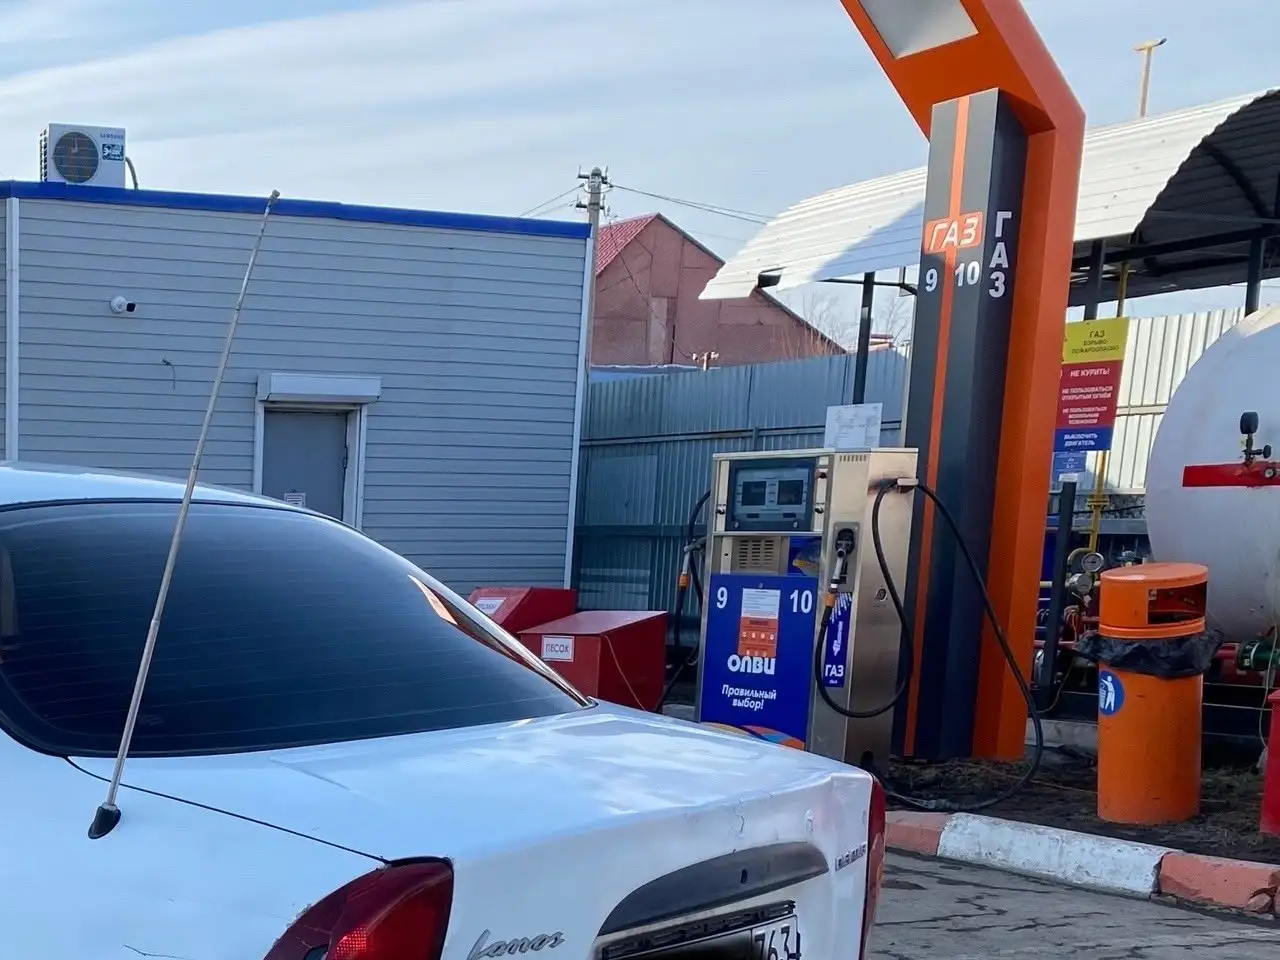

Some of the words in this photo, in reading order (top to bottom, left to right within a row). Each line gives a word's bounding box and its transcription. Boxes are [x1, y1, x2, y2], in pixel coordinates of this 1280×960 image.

[929, 216, 979, 251] ГАЗ
[989, 211, 1012, 298] ГАЗ
[925, 268, 938, 292] 9
[955, 260, 980, 287] 10
[1089, 330, 1105, 339] ГАЗ
[1070, 370, 1080, 378] НЕ
[1080, 368, 1110, 377] КУРИТЬ!
[716, 587, 728, 609] 9
[789, 589, 813, 614] 10
[545, 643, 569, 653] ПЕСОК
[825, 664, 844, 677] ГАЗ
[721, 684, 777, 700] Правильный
[732, 698, 764, 711] выбор!
